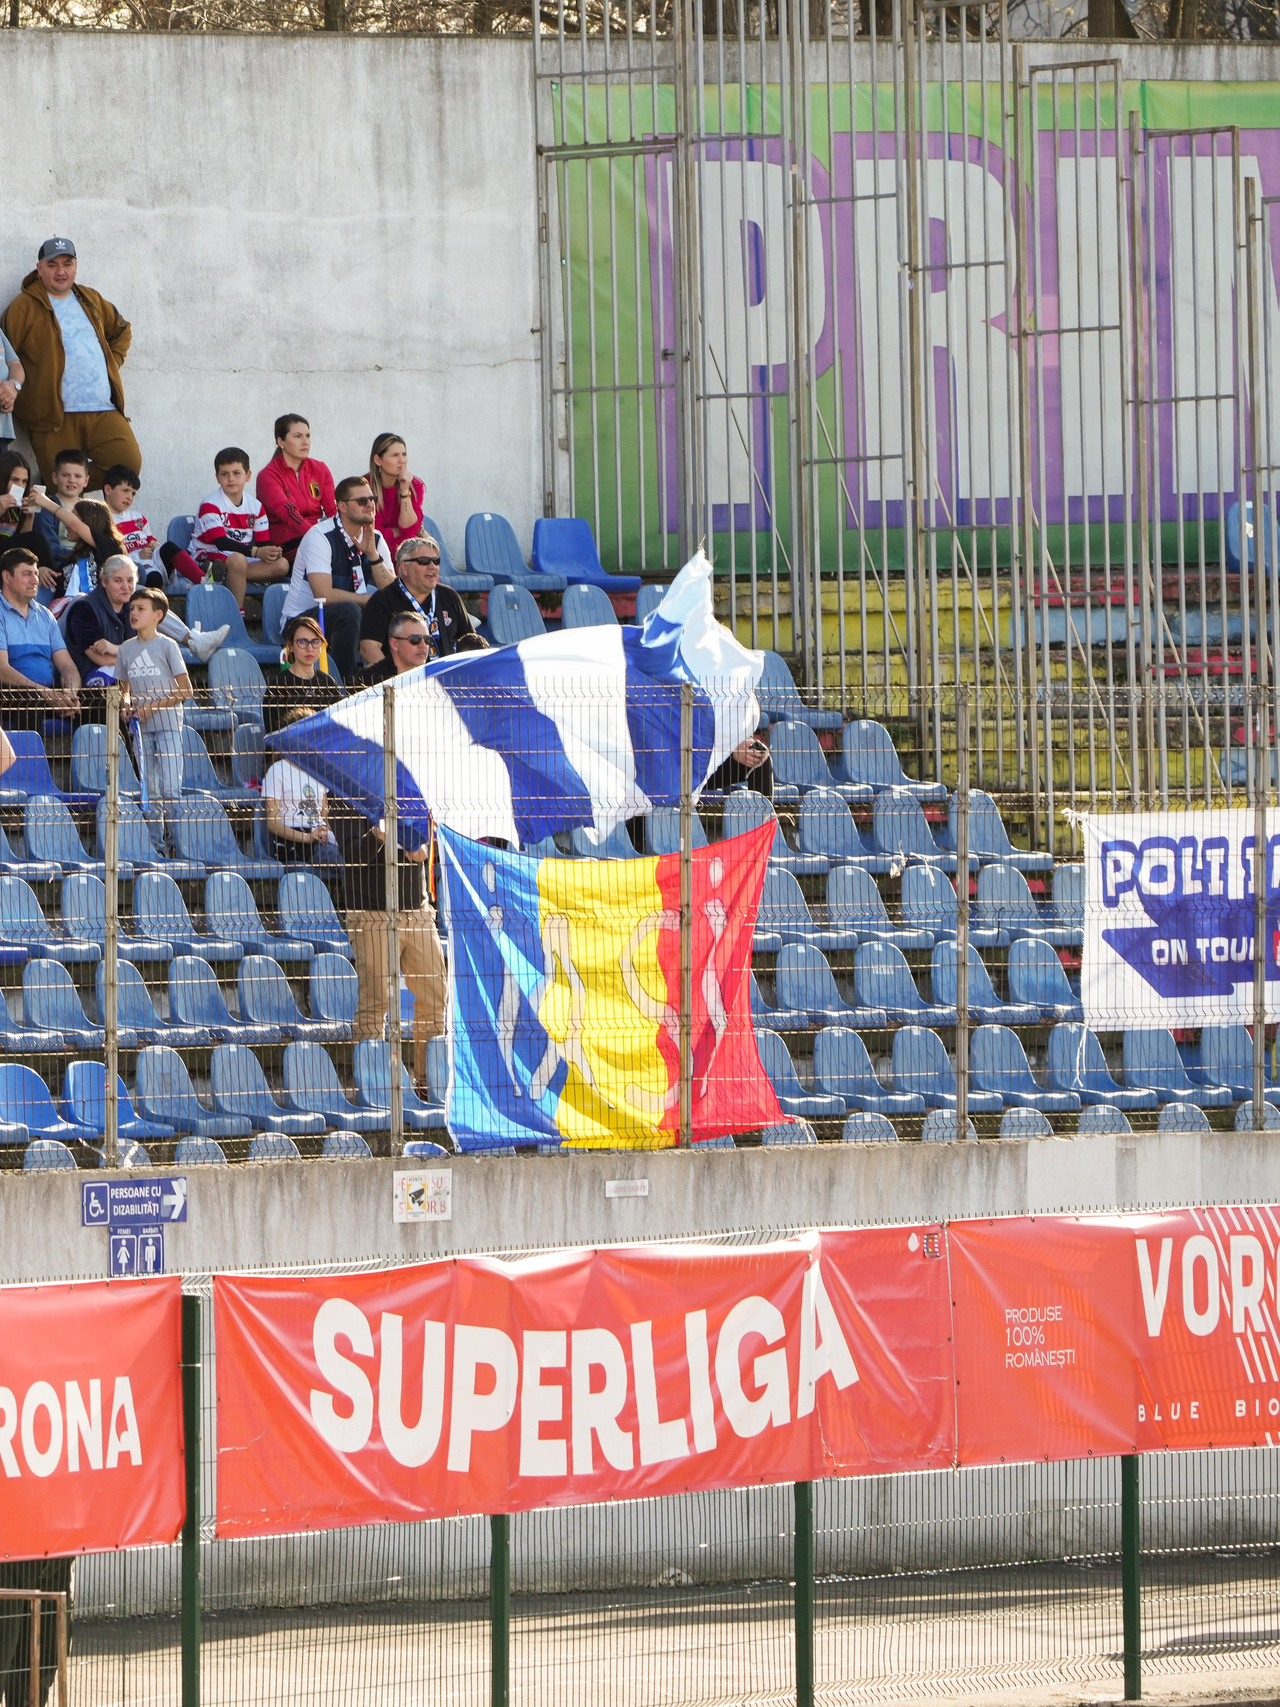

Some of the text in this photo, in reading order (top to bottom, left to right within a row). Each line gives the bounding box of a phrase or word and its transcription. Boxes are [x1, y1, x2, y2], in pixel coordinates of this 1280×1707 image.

[127, 666, 161, 678] adidas
[1102, 840, 1228, 904] POLI
[1151, 936, 1255, 966] ON TOU
[111, 1185, 162, 1199] PERSOANE CU
[1135, 1234, 1280, 1338] VOR
[1005, 1306, 1063, 1324] PRODUSE
[1005, 1325, 1046, 1347] 100%
[309, 1259, 861, 1478] SUPERLIGA
[1005, 1348, 1076, 1369] ROMÂNEȘTI
[1137, 1401, 1200, 1422] BLUE
